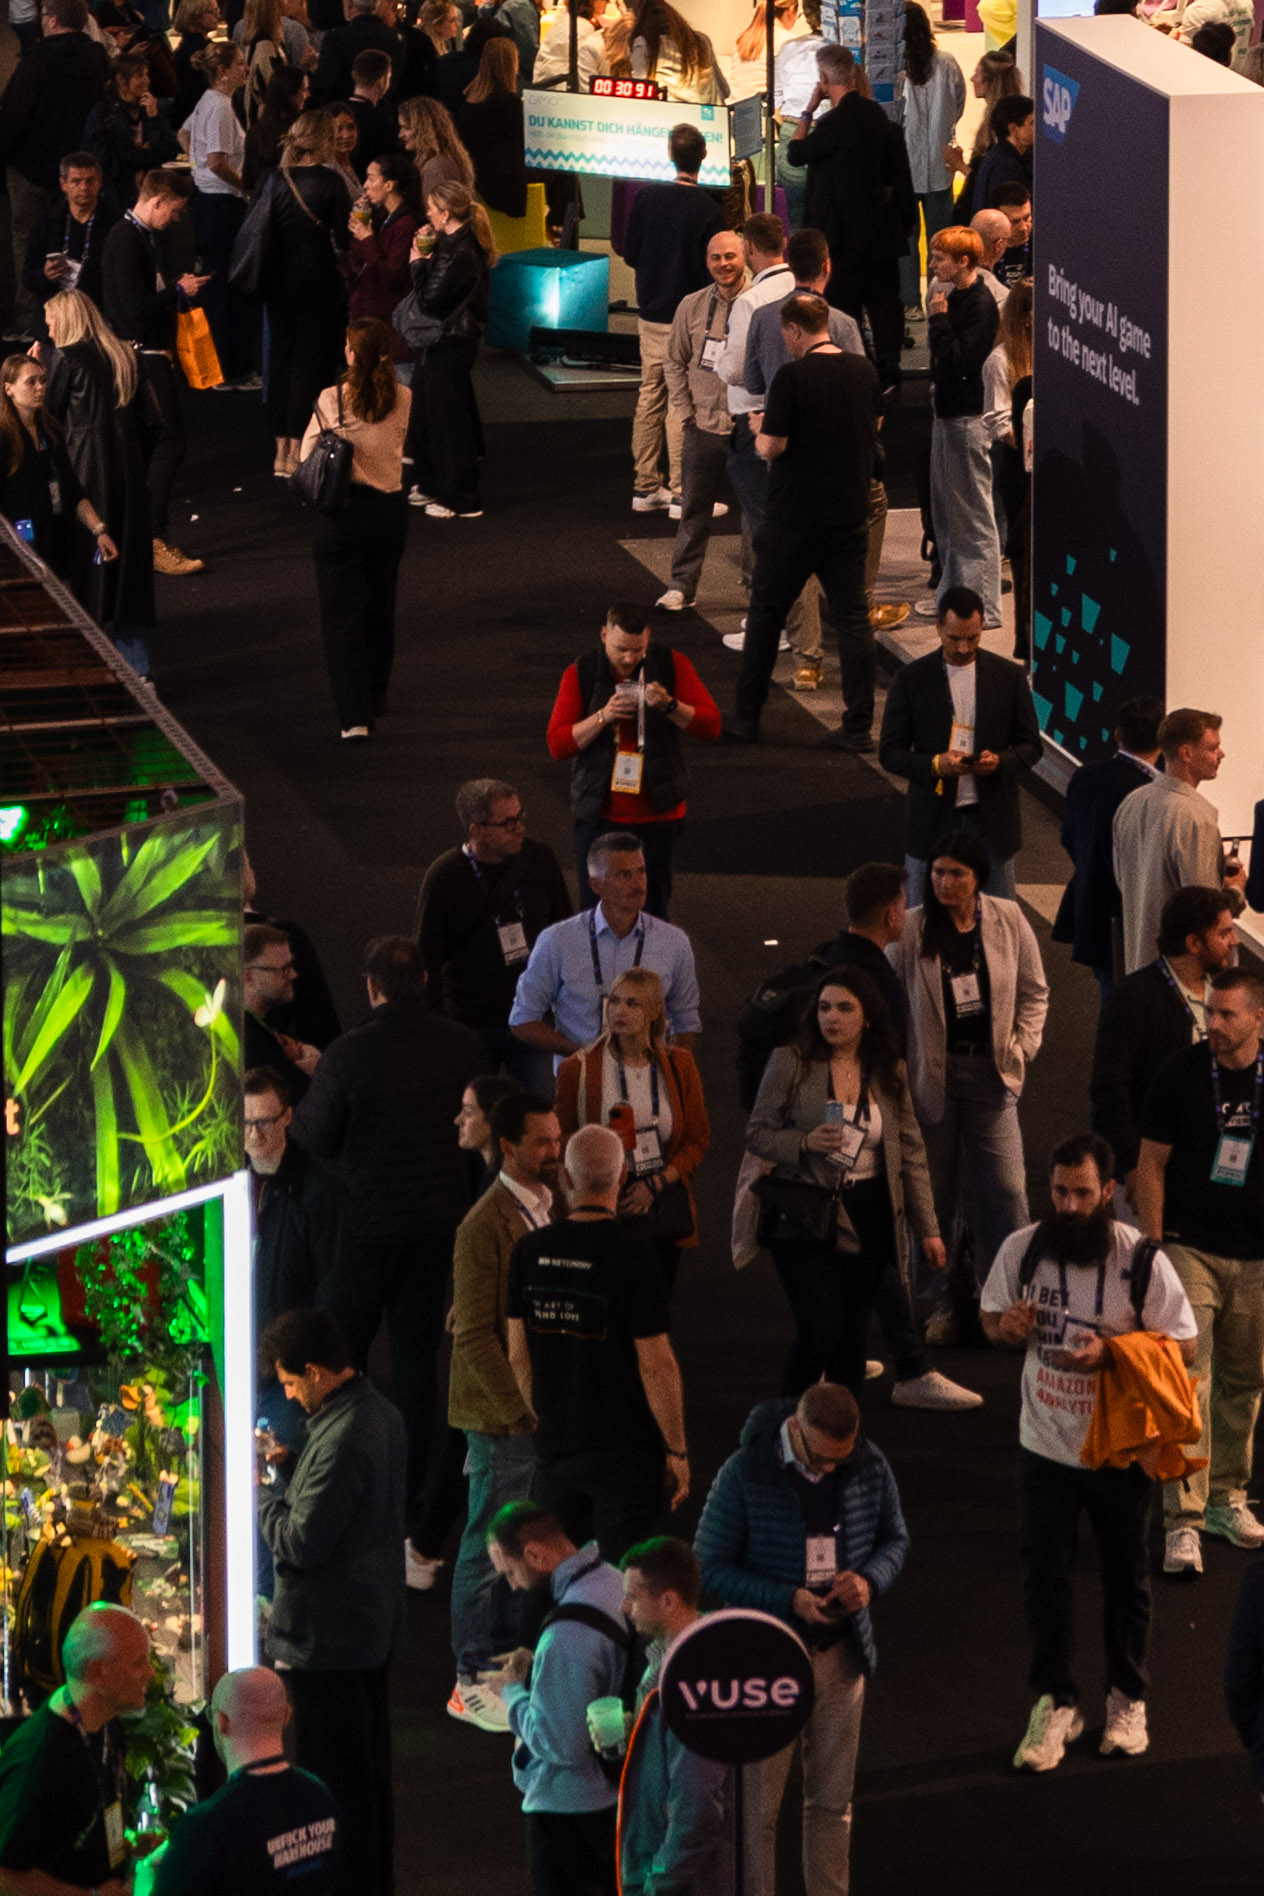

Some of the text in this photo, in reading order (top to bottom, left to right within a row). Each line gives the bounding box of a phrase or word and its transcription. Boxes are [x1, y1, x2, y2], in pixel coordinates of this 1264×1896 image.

[528, 115, 545, 128] DU
[547, 116, 594, 132] KANNST
[597, 120, 624, 134] DICH
[1043, 76, 1071, 134] SAP
[1048, 263, 1077, 320] Bring
[1078, 287, 1104, 325] your
[1105, 302, 1118, 339] AI
[1119, 315, 1151, 359] game
[1048, 316, 1140, 406] to the next level.
[1037, 1368, 1097, 1396] AMAZON
[307, 1817, 335, 1839] YOUR
